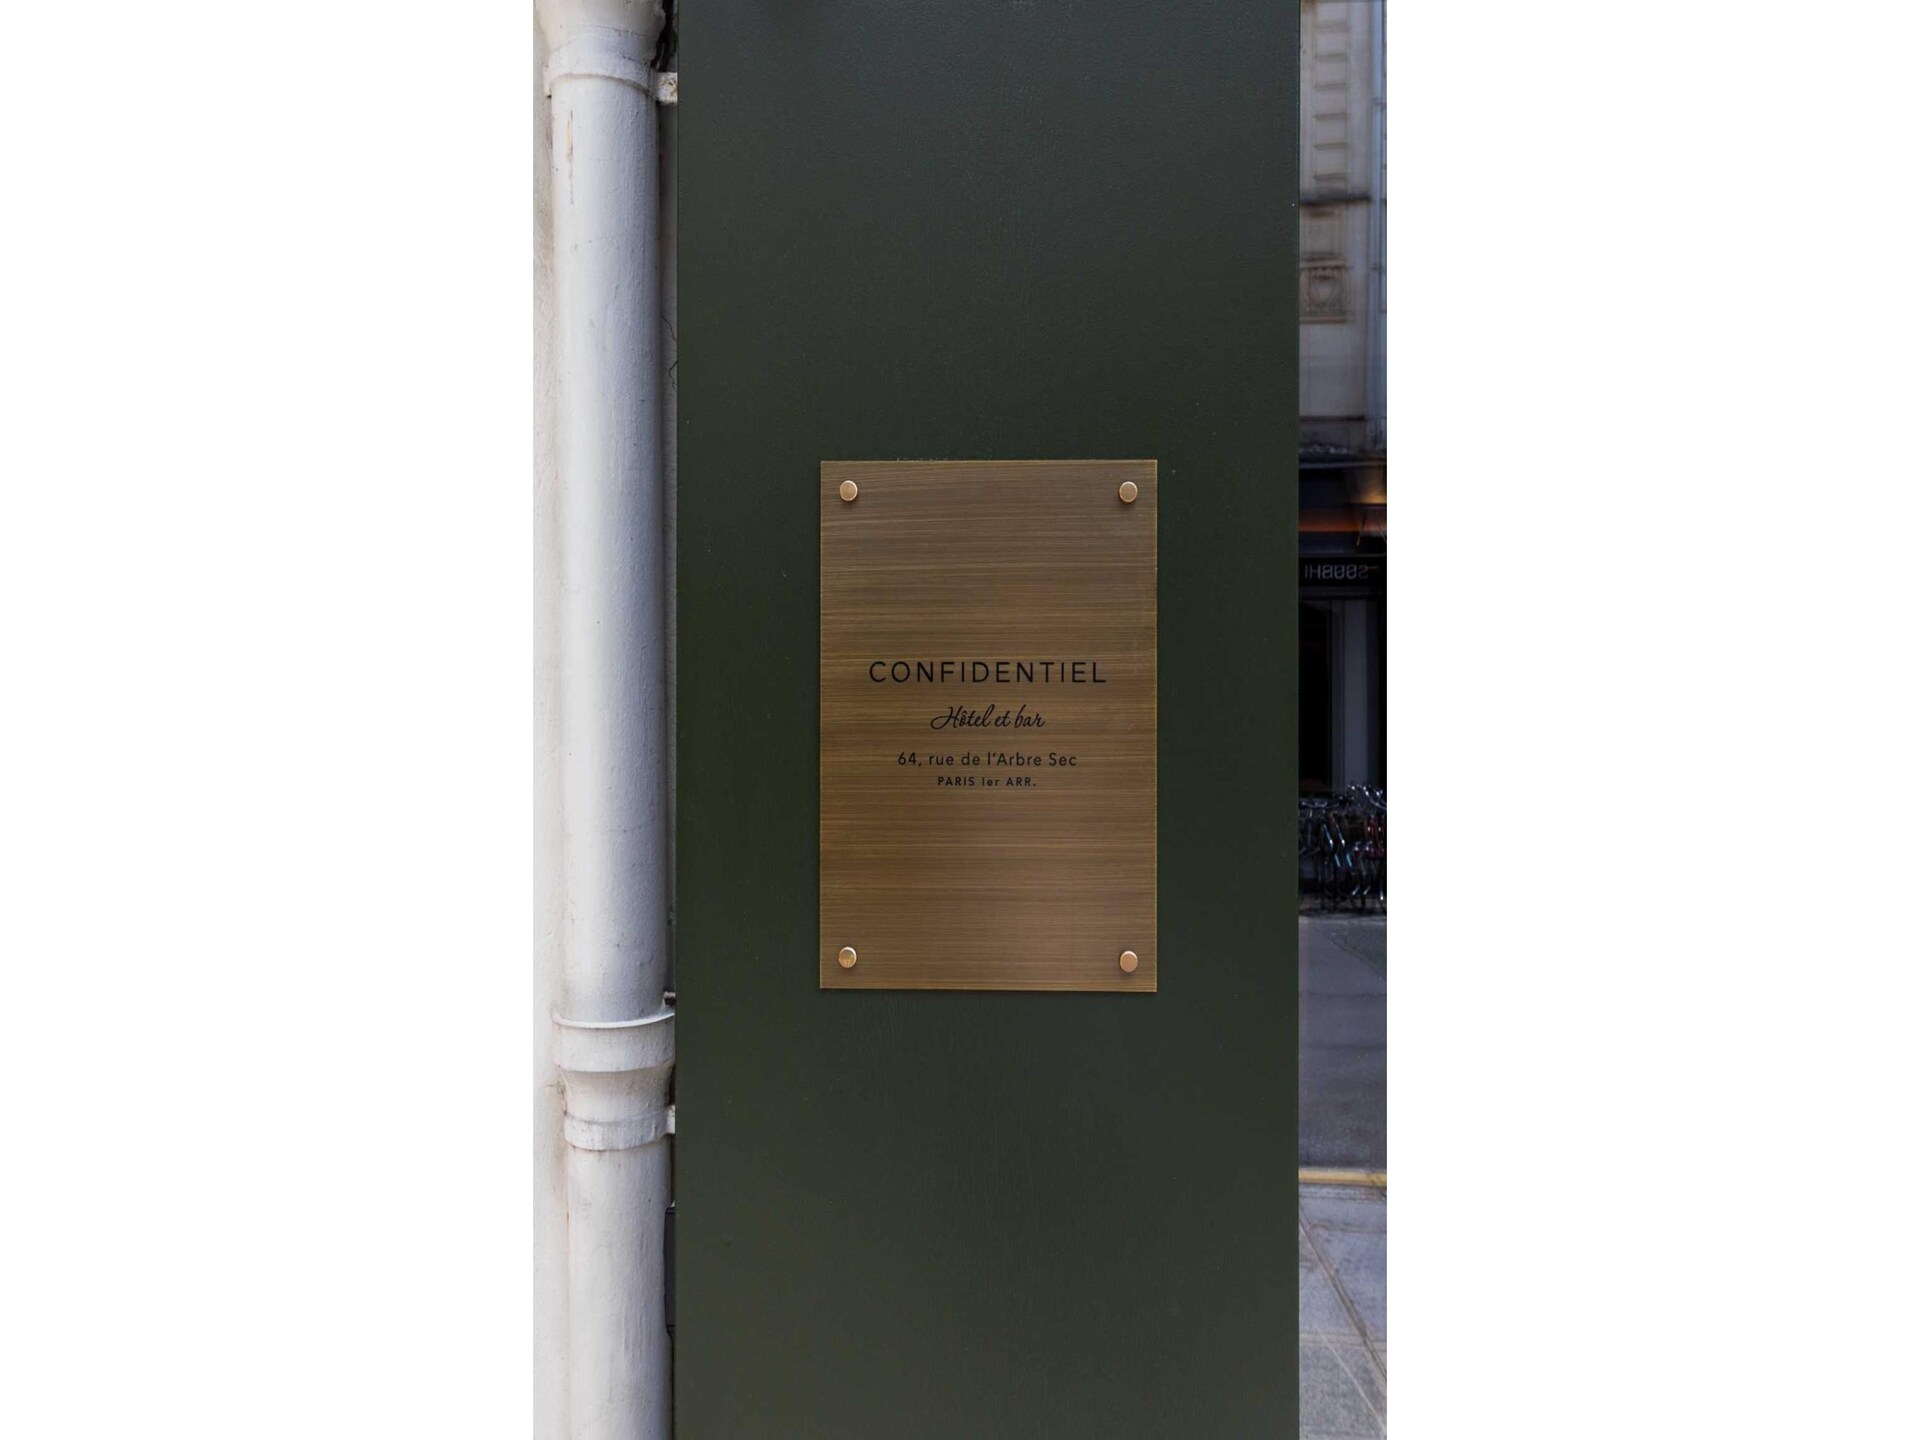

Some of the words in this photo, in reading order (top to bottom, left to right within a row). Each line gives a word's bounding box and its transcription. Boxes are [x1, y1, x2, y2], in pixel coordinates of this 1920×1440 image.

[869, 661, 1107, 683] CONFIDENTIEL
[930, 704, 995, 730] Hôtel
[994, 710, 1012, 728] et
[1014, 704, 1045, 728] bar
[897, 752, 922, 767] 64,
[928, 755, 954, 766] rue
[961, 752, 980, 766] de
[987, 752, 1042, 766] l’Arbre
[1048, 753, 1077, 766] Sec
[937, 776, 975, 787] PARIS
[1006, 776, 1037, 787] ARR.
